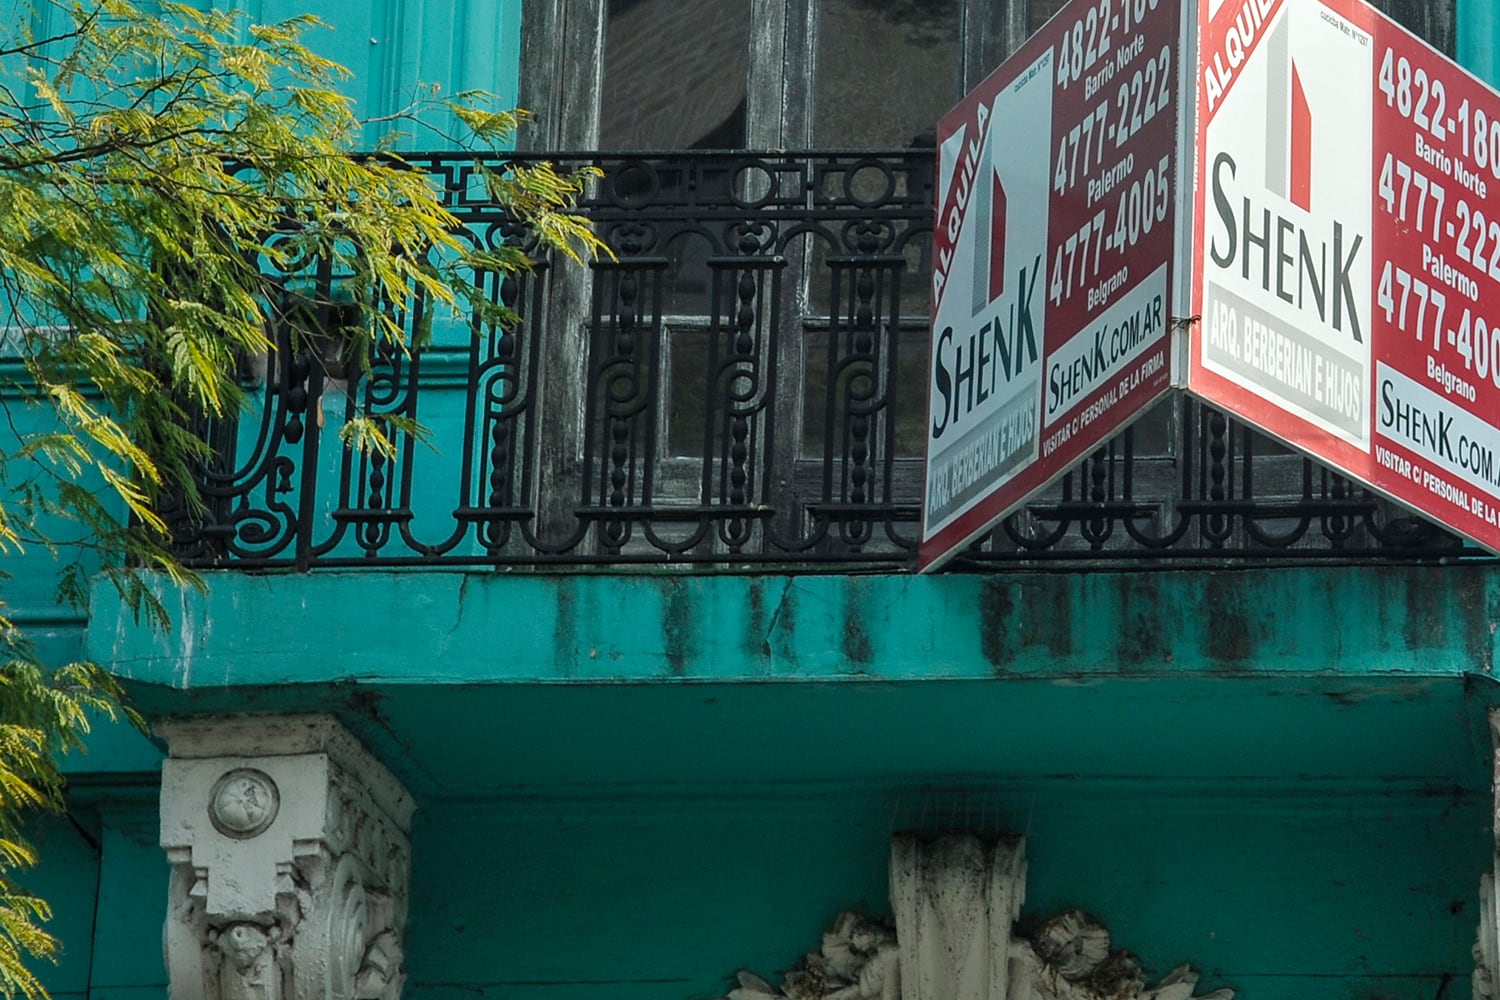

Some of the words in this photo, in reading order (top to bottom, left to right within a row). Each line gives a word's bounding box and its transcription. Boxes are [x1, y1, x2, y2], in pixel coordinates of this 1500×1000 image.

[1085, 60, 1114, 101] Barrio
[1117, 34, 1144, 73] Norte
[1054, 45, 1170, 197] 4777-2222
[1415, 132, 1451, 175] Barrio
[1454, 157, 1487, 199] Norte
[933, 102, 989, 308] ALQUILA
[1050, 155, 1169, 307] 4777-4005
[1087, 153, 1134, 208] Palermo
[1087, 266, 1128, 311] Belgrano
[1210, 151, 1364, 345] SHENK
[1422, 243, 1478, 302] Palermo
[932, 253, 1042, 439] SHENK
[1049, 294, 1162, 414] SHENK.COM.AR
[1211, 299, 1241, 360] ARQ.
[1244, 315, 1312, 396] BERBERIAN
[1314, 353, 1323, 402] E
[1325, 358, 1361, 422] HIJOS
[1427, 354, 1476, 403] Belgrano
[951, 434, 998, 498] BERBERIAN
[1007, 403, 1034, 451] HIJOS
[1043, 425, 1071, 458] VISITAR
[1080, 389, 1118, 429] PERSONAL
[1119, 376, 1129, 398] DE
[1130, 369, 1140, 390] LA
[1140, 351, 1165, 385] FIRMA
[1375, 444, 1411, 480] VISITAR
[1413, 465, 1422, 485] C/
[1423, 470, 1469, 511] PERSONAL
[1472, 497, 1483, 518] DE
[1485, 504, 1496, 526] LA
